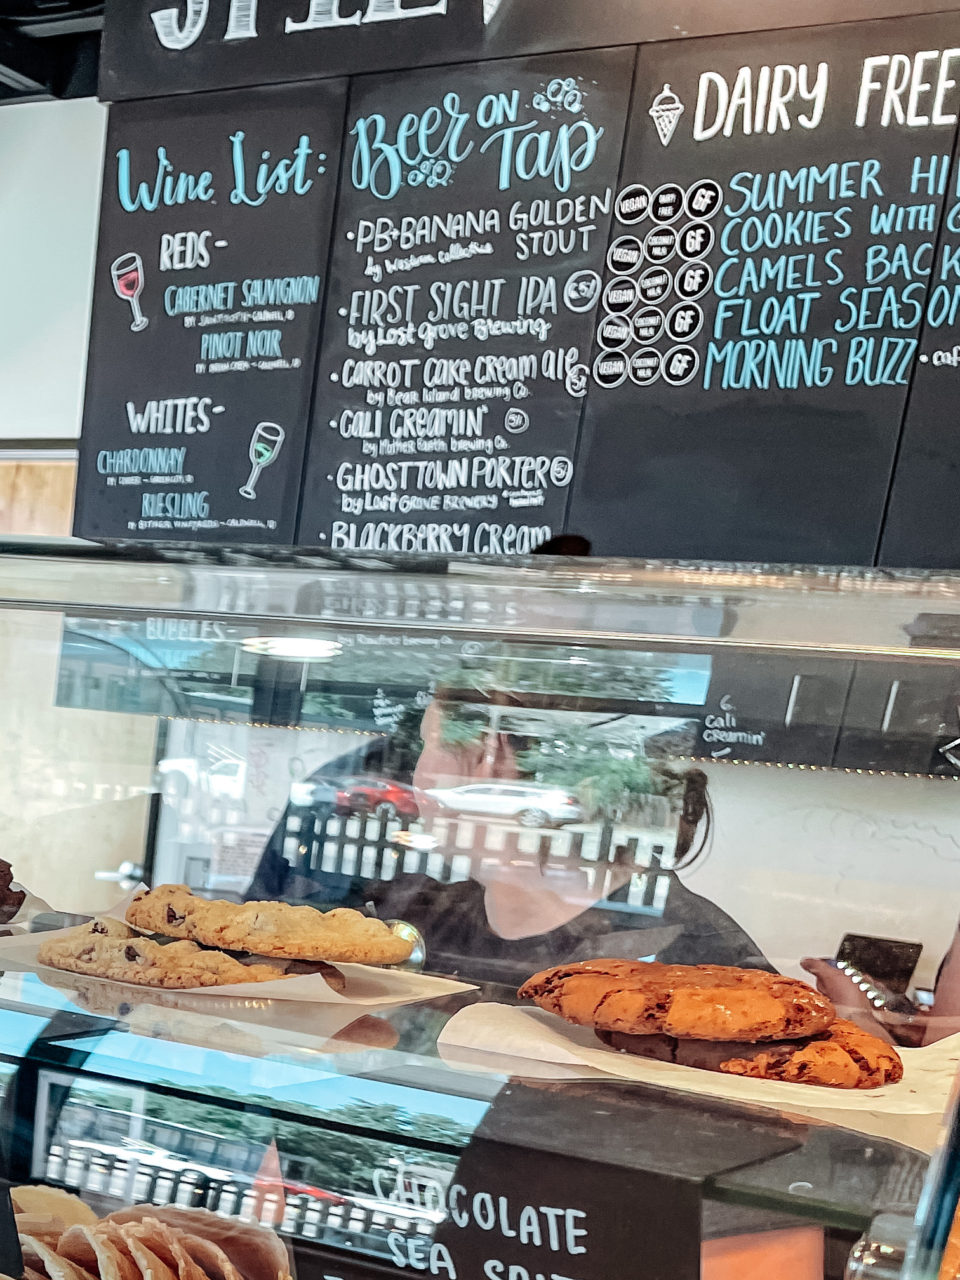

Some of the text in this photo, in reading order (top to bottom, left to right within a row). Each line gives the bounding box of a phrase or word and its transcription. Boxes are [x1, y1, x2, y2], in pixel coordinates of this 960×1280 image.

[693, 48, 960, 141] DAIRY FREE
[349, 92, 474, 199] Beer
[480, 119, 605, 193] Tap
[116, 130, 327, 212] Wine List:
[724, 159, 884, 217] SUMMER
[509, 187, 612, 231] GOLDEN
[620, 195, 648, 214] VEGAN
[692, 188, 716, 212] GF
[516, 225, 596, 260] STOUT
[685, 228, 706, 253] GF
[720, 206, 853, 256] COOKIES
[870, 204, 936, 235] WITH
[612, 247, 640, 264] VEGAN
[683, 269, 705, 292] GF
[714, 249, 844, 298] CAMELS
[164, 275, 321, 316] CABERNET SAUVIGNON
[349, 284, 421, 327] FIRST
[427, 278, 507, 323] SIGHT
[517, 276, 557, 317] IPA
[608, 288, 635, 304] VEGAN
[674, 310, 696, 333] GF
[714, 292, 822, 340] FLOAT
[200, 329, 282, 361] PINOT NOIR
[347, 328, 377, 356] by
[598, 360, 624, 375] VEGAN
[669, 353, 692, 377] GF
[703, 338, 838, 390] MORNING
[844, 336, 918, 386] BUZZ
[97, 447, 187, 474] CHARDONNAY
[142, 491, 209, 518] RIESLING
[372, 1166, 588, 1255] CHOCOLATE
[387, 1231, 457, 1280] SEA
